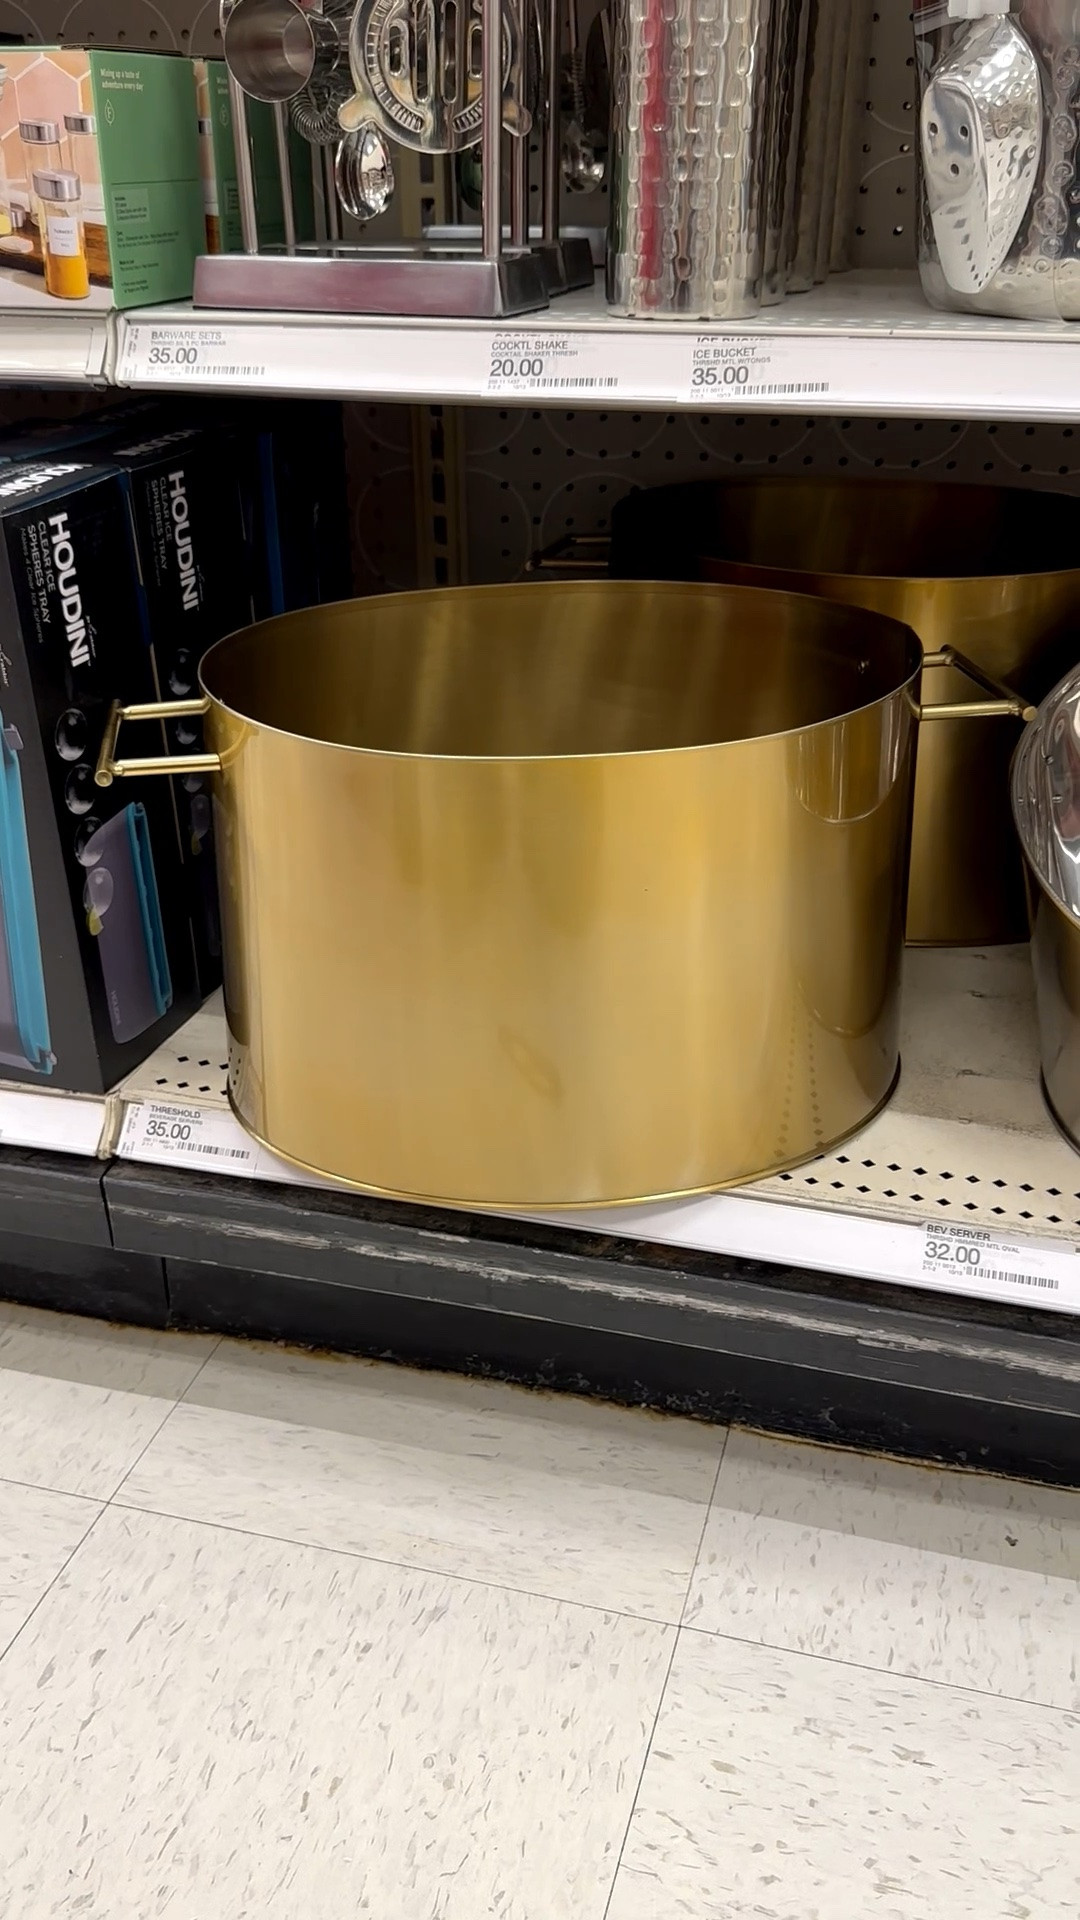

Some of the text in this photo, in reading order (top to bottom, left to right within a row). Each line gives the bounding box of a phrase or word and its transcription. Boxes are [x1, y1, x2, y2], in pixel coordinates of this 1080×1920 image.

[151, 331, 222, 340] BARWARE SETS
[491, 340, 569, 351] COCKTL SHAKE
[148, 347, 198, 364] 35.00
[693, 347, 757, 359] ICE BUCKET
[489, 358, 544, 377] 20.00
[691, 366, 749, 386] 35.00
[159, 476, 173, 543] CLEAR ICE
[150, 479, 165, 537] SPHERES
[158, 539, 168, 571] TRAY
[168, 470, 200, 612] HOUDINI
[37, 520, 56, 593] CLEAR ICE
[27, 524, 51, 625] SPHERES TRAY
[20, 527, 30, 556] Makes
[25, 566, 35, 592] Clear
[32, 607, 44, 643] Spheres
[48, 511, 90, 667] HOUDINI
[149, 1113, 203, 1126] BEVERAGE SERVERS
[150, 1104, 201, 1119] THRESHOLD
[146, 1120, 191, 1140] 35.00
[926, 1224, 991, 1241] BEV SERVER
[924, 1241, 981, 1265] 32.00
[926, 1233, 954, 1243] THRSHD
[954, 1238, 985, 1248] HMMRED
[1002, 1245, 1020, 1254] OVAL
